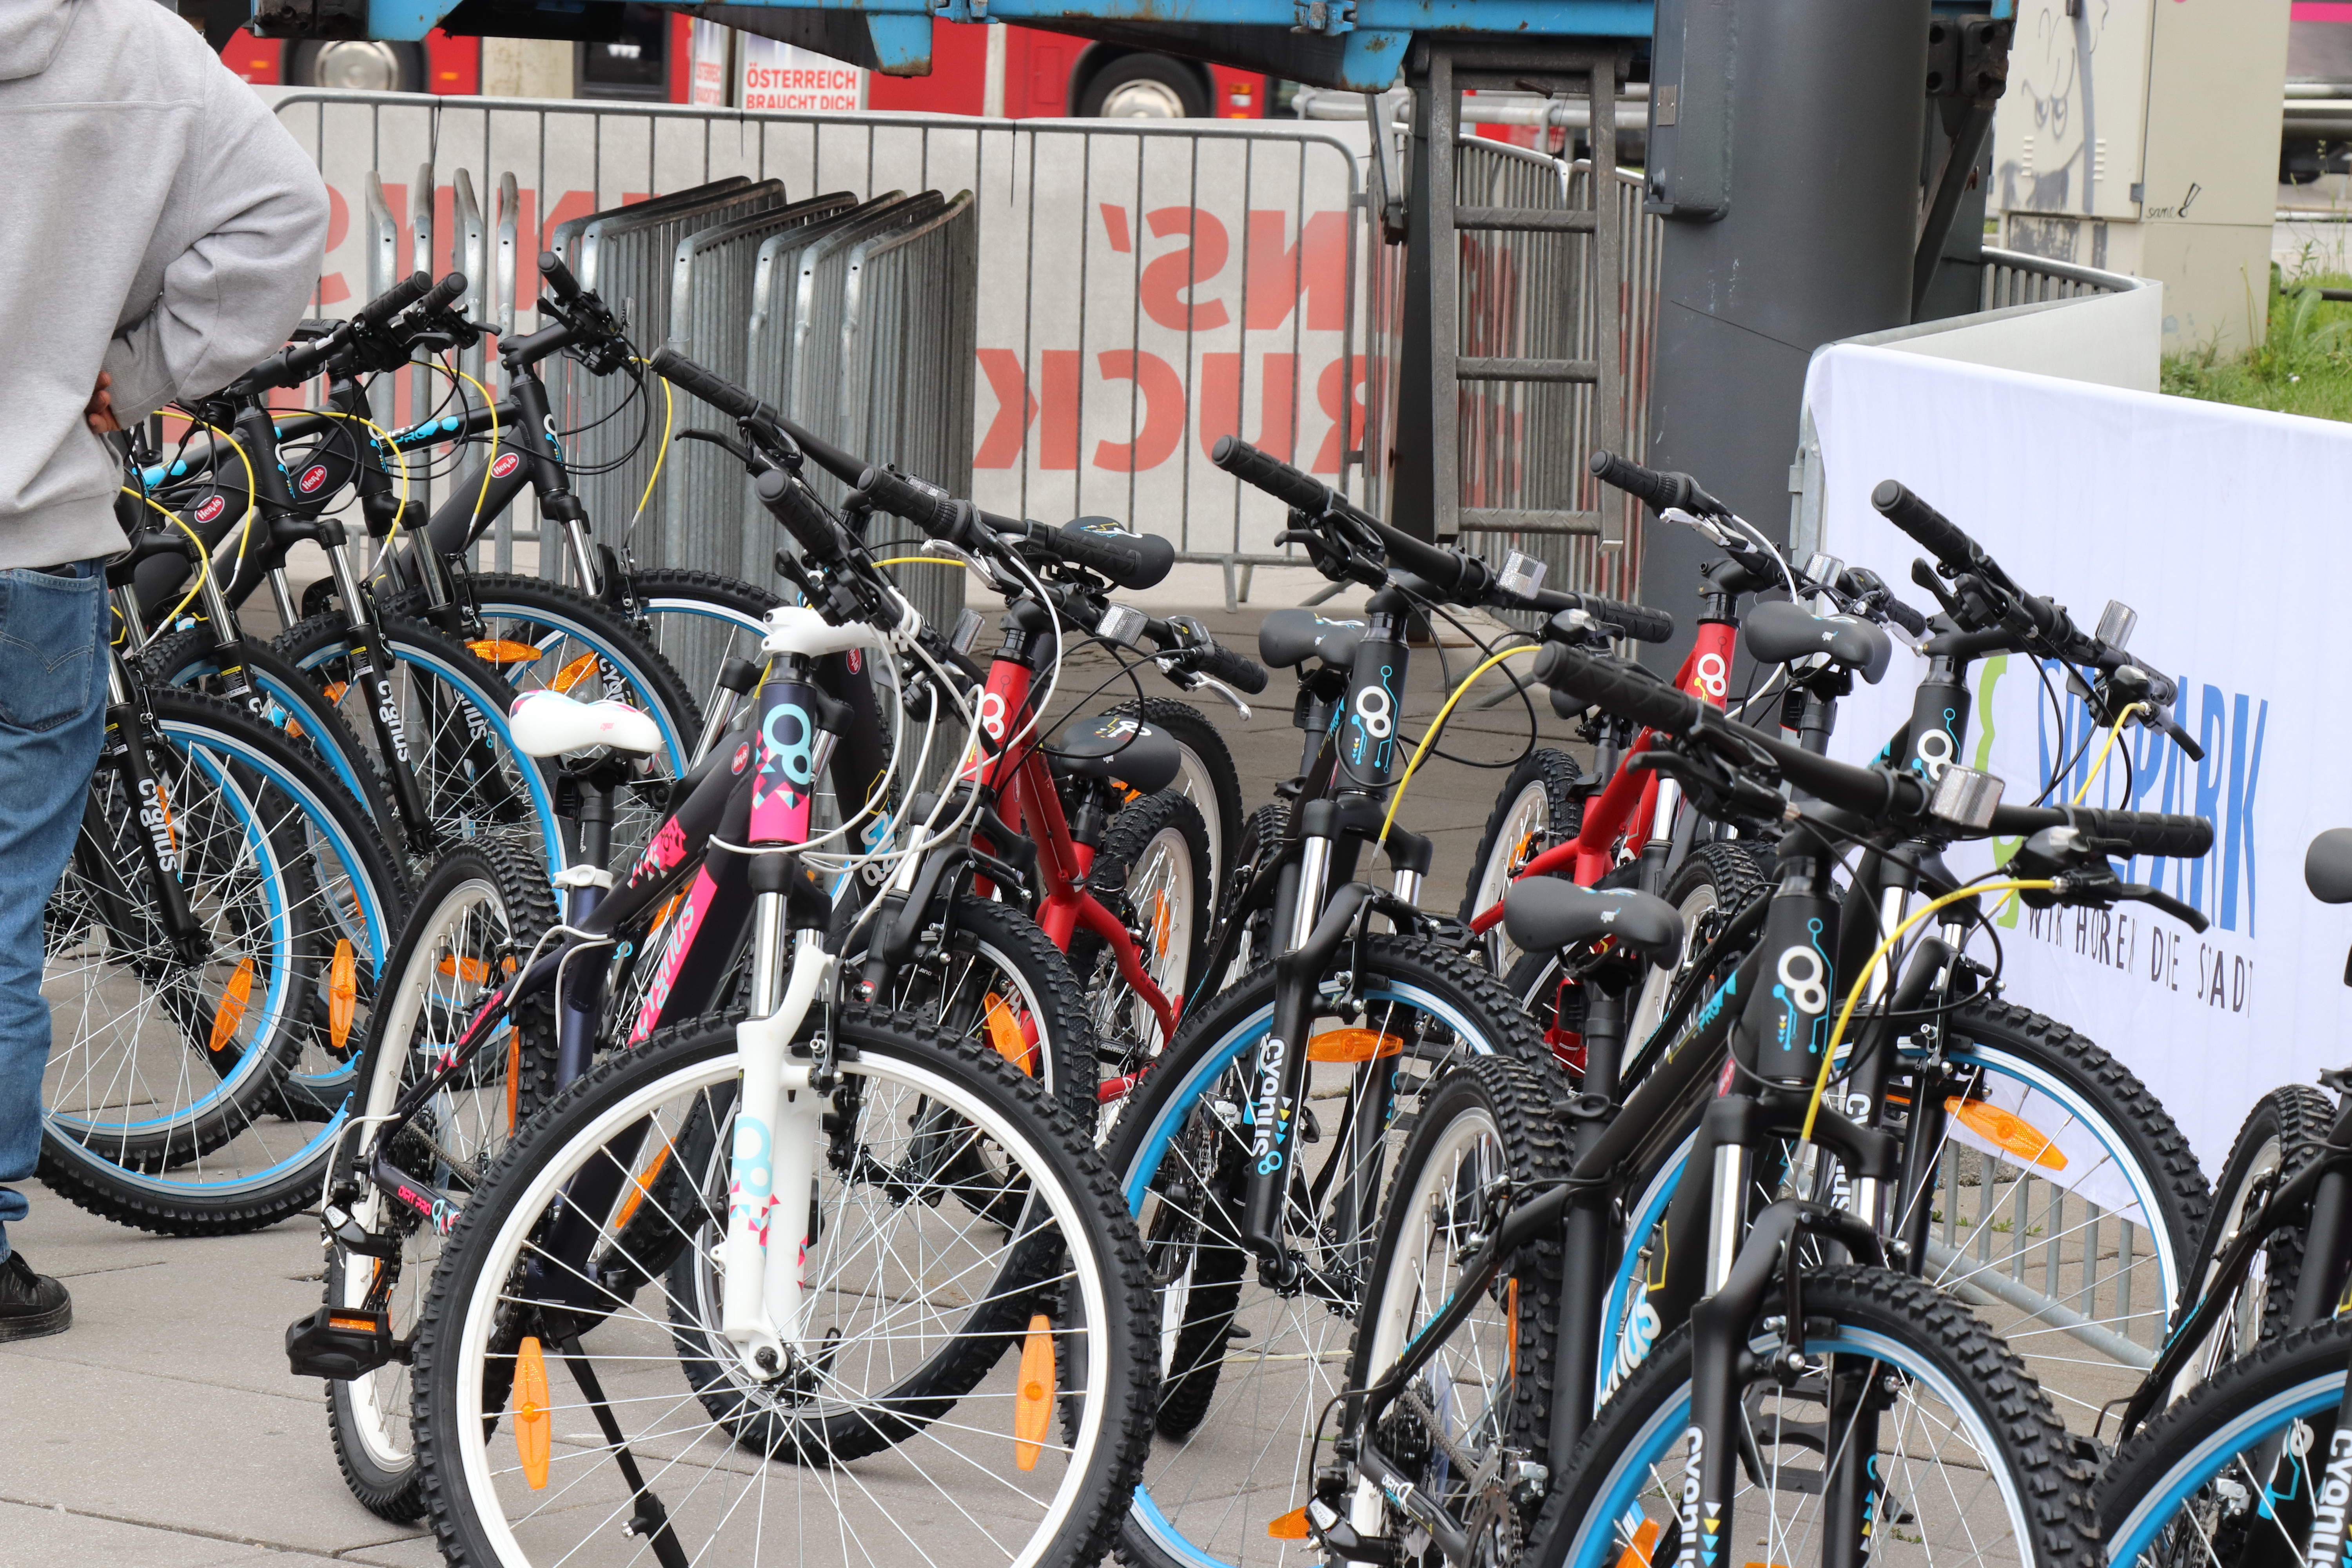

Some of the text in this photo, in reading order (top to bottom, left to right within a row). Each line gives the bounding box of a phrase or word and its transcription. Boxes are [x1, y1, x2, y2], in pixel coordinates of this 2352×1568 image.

[747, 62, 856, 89] ÖSTERREICH
[746, 94, 855, 110] BRAUCHT DICH
[493, 455, 516, 475] Hervis
[301, 468, 325, 490] Hervis
[197, 498, 221, 520] Hervis
[377, 680, 411, 762] cygnus
[733, 748, 748, 769] Hervis
[138, 778, 177, 872] cygnus
[637, 894, 694, 1037] cygnus
[2151, 926, 2181, 991] DIE
[2198, 942, 2254, 1018] STADT
[1101, 1044, 1126, 1055] QUANDO
[397, 1185, 432, 1215] DIRT PRO
[326, 1209, 340, 1223] ALTUS
[1381, 1474, 1400, 1493] DIRT
[2307, 1429, 2352, 1568] cygnu
[1312, 1505, 1329, 1524] ALTUS
